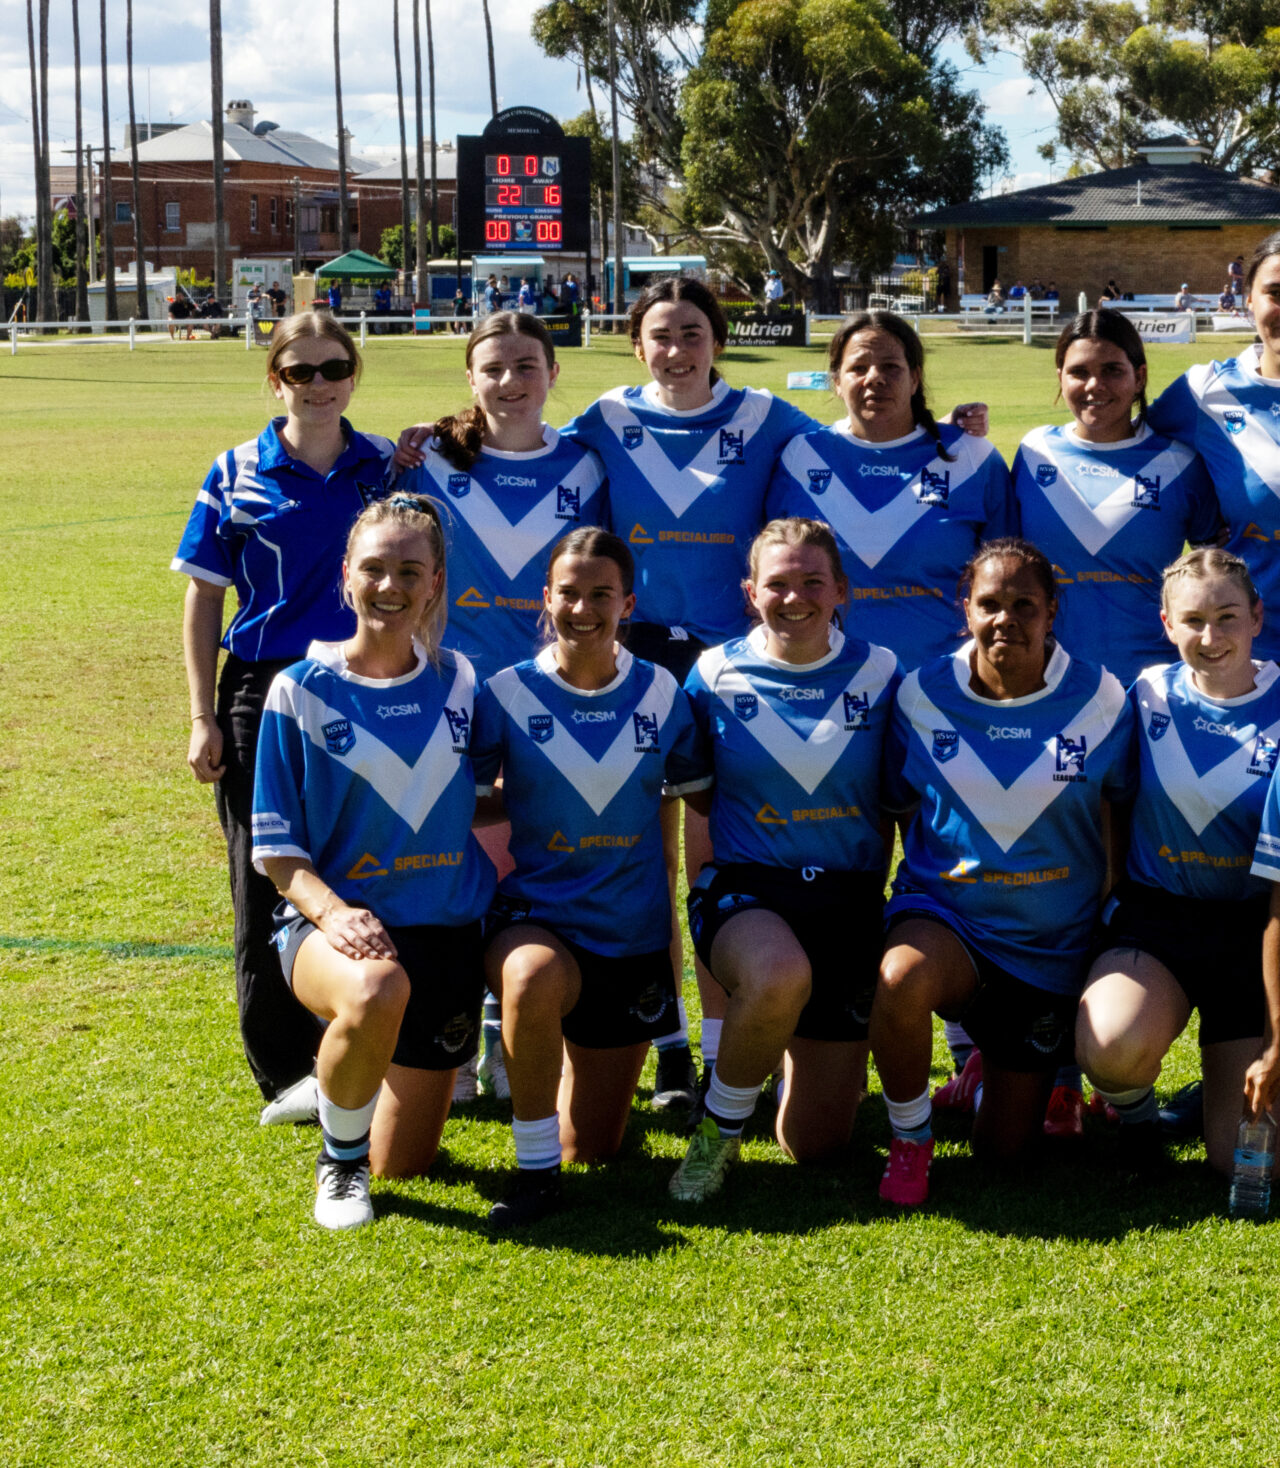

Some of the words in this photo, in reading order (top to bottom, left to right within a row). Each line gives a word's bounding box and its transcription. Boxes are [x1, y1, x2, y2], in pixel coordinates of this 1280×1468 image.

[498, 154, 510, 176] 0
[525, 154, 538, 176] 0
[498, 185, 521, 205] 22
[544, 185, 561, 205] 16
[486, 221, 510, 242] 00
[537, 221, 561, 242] 00
[728, 321, 792, 336] Nutrien
[872, 466, 899, 476] CSM
[1090, 465, 1119, 478] CSM
[508, 476, 537, 487] CSM
[659, 530, 735, 544] SPECIALISED
[793, 688, 824, 700] CSM
[390, 703, 421, 717] CSM
[587, 711, 616, 722] CSM
[326, 722, 348, 735] NSW
[999, 727, 1032, 739] CSM
[935, 732, 955, 741] NSW
[983, 867, 1070, 886] SPECIALISED
